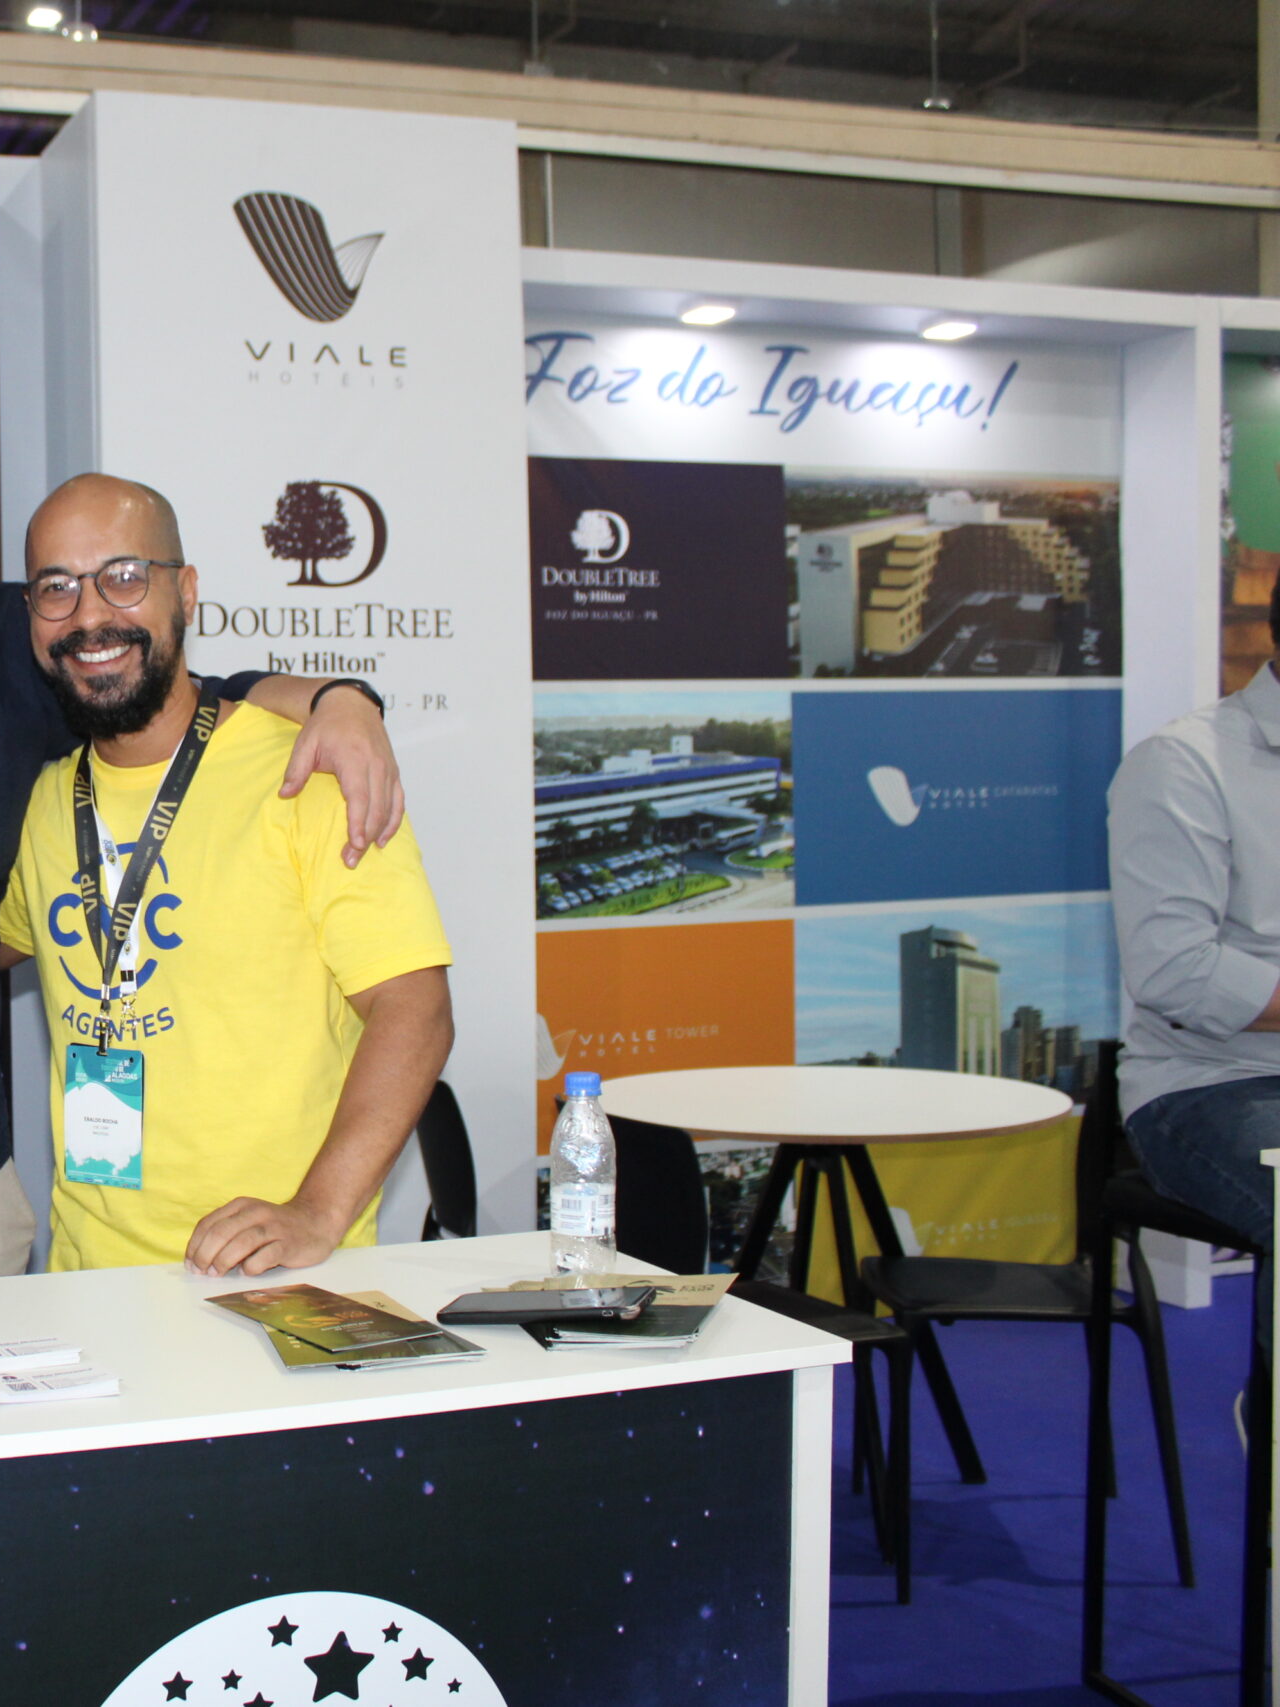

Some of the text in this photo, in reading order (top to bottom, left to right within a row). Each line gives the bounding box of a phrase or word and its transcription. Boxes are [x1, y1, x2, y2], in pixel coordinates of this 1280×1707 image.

[245, 340, 407, 367] VIALE
[524, 331, 1019, 433] Foz do Iguaçu!
[269, 652, 295, 674] by
[423, 693, 448, 710] PR
[193, 706, 217, 742] VIP
[74, 772, 92, 809] VIP
[929, 786, 989, 799] VIALE
[150, 800, 178, 841] VIP
[81, 874, 98, 915] VIP
[113, 902, 138, 942] VIP
[578, 1024, 720, 1045] VIALE TOWER
